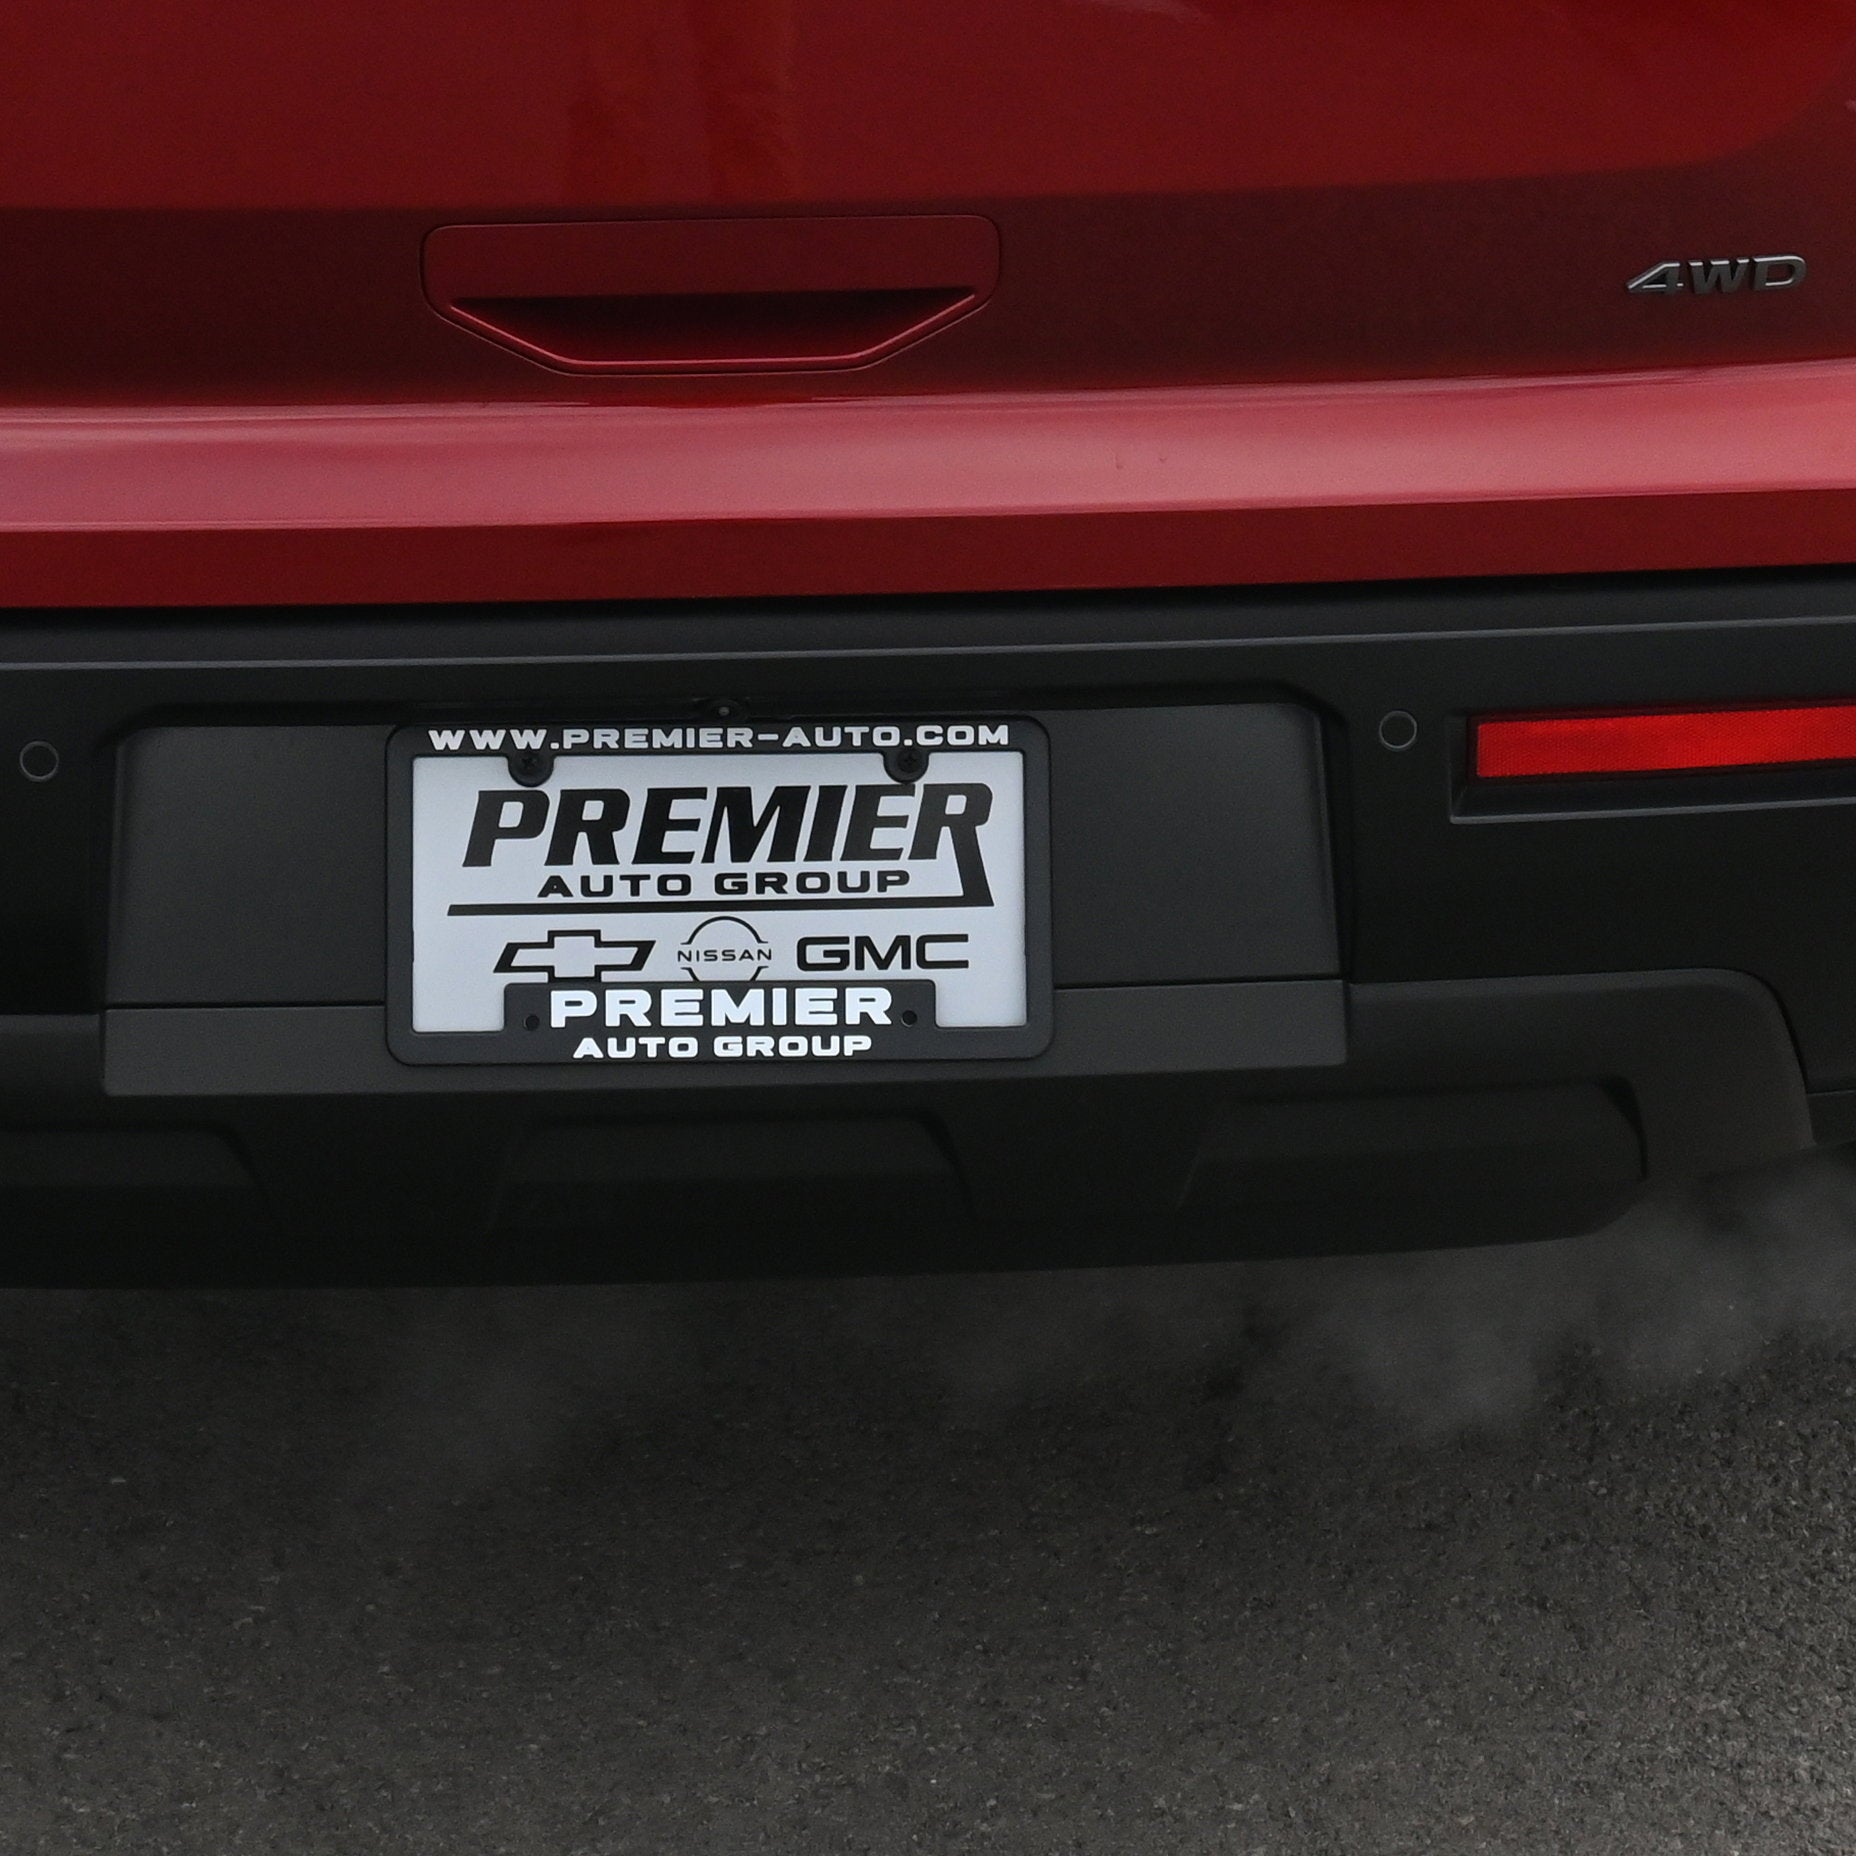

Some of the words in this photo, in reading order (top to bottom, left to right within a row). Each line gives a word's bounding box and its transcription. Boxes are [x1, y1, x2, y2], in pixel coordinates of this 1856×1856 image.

[1625, 255, 1807, 294] 4WD
[428, 724, 1010, 751] WWW.PREMIER-AUTO.COM
[462, 783, 994, 907] PREMIER
[537, 873, 693, 898] AUTO
[714, 870, 910, 895] GROUP
[678, 947, 773, 964] NISSAN
[797, 934, 970, 971] GMC
[550, 987, 893, 1028] PREMIER
[573, 1037, 700, 1059] AUTO
[713, 1035, 873, 1058] GROUP
